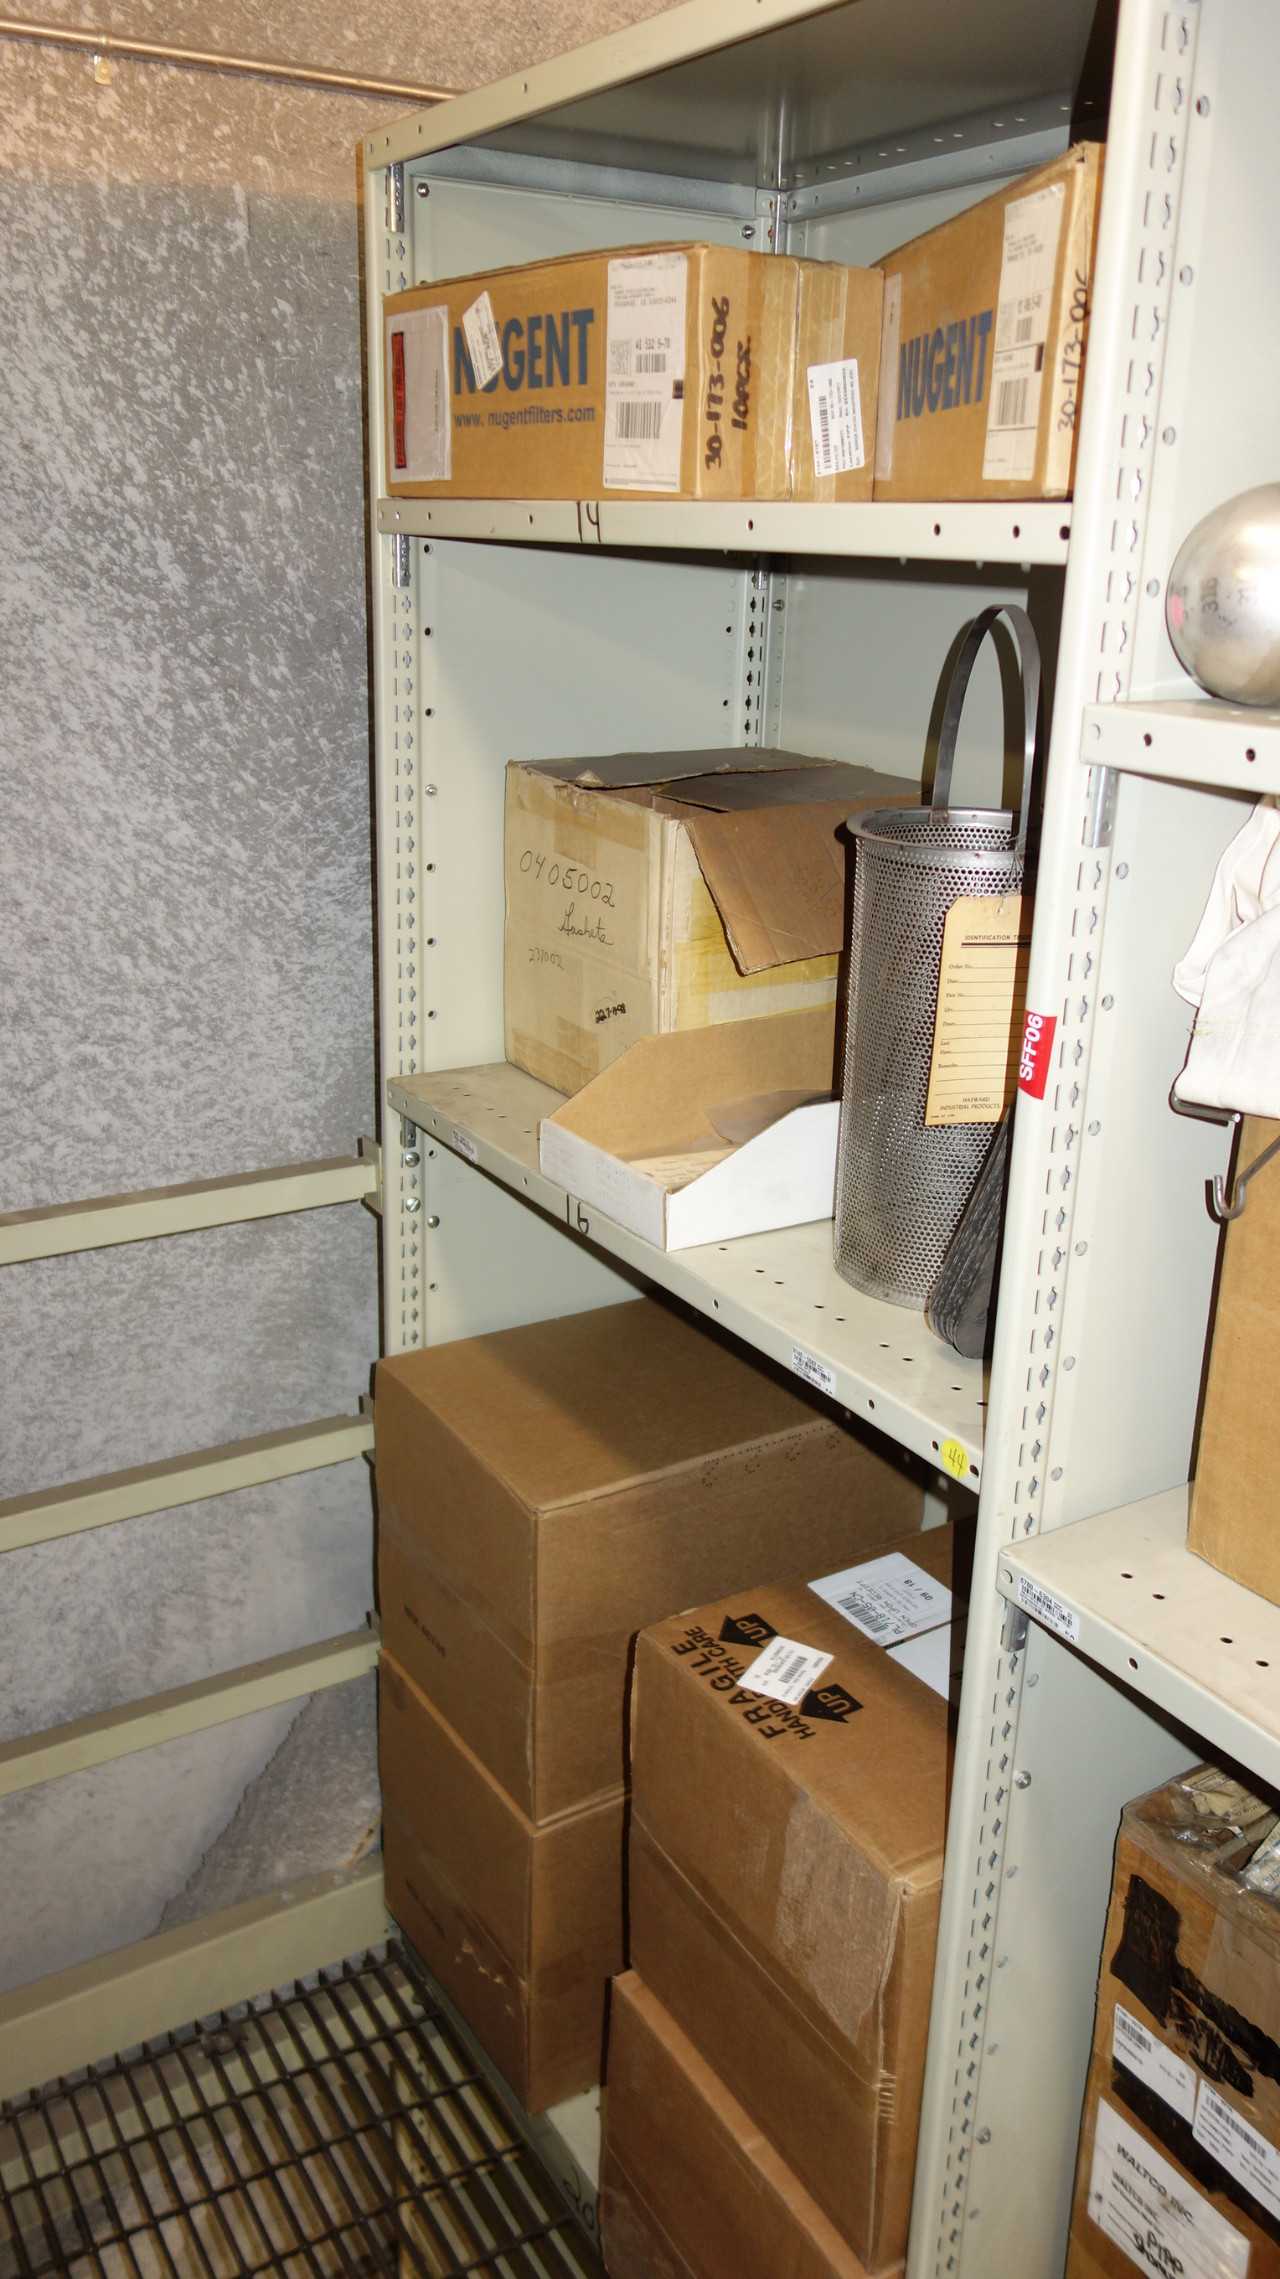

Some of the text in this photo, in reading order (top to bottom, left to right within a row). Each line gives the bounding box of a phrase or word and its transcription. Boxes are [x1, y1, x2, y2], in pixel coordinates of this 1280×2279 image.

[704, 295, 730, 471] 30-173-006
[895, 308, 993, 421] NUGENT
[577, 501, 602, 543] 14
[519, 850, 616, 908] 0405002
[964, 934, 1011, 942] IDENTIFICATION
[1019, 1013, 1044, 1081] SFF06
[566, 1193, 590, 1236] 16
[948, 1447, 964, 1475] 44
[684, 1625, 727, 1657] CARE
[735, 1619, 768, 1641] UP
[671, 1640, 788, 1740] FRAGILE
[816, 1690, 852, 1716] UP
